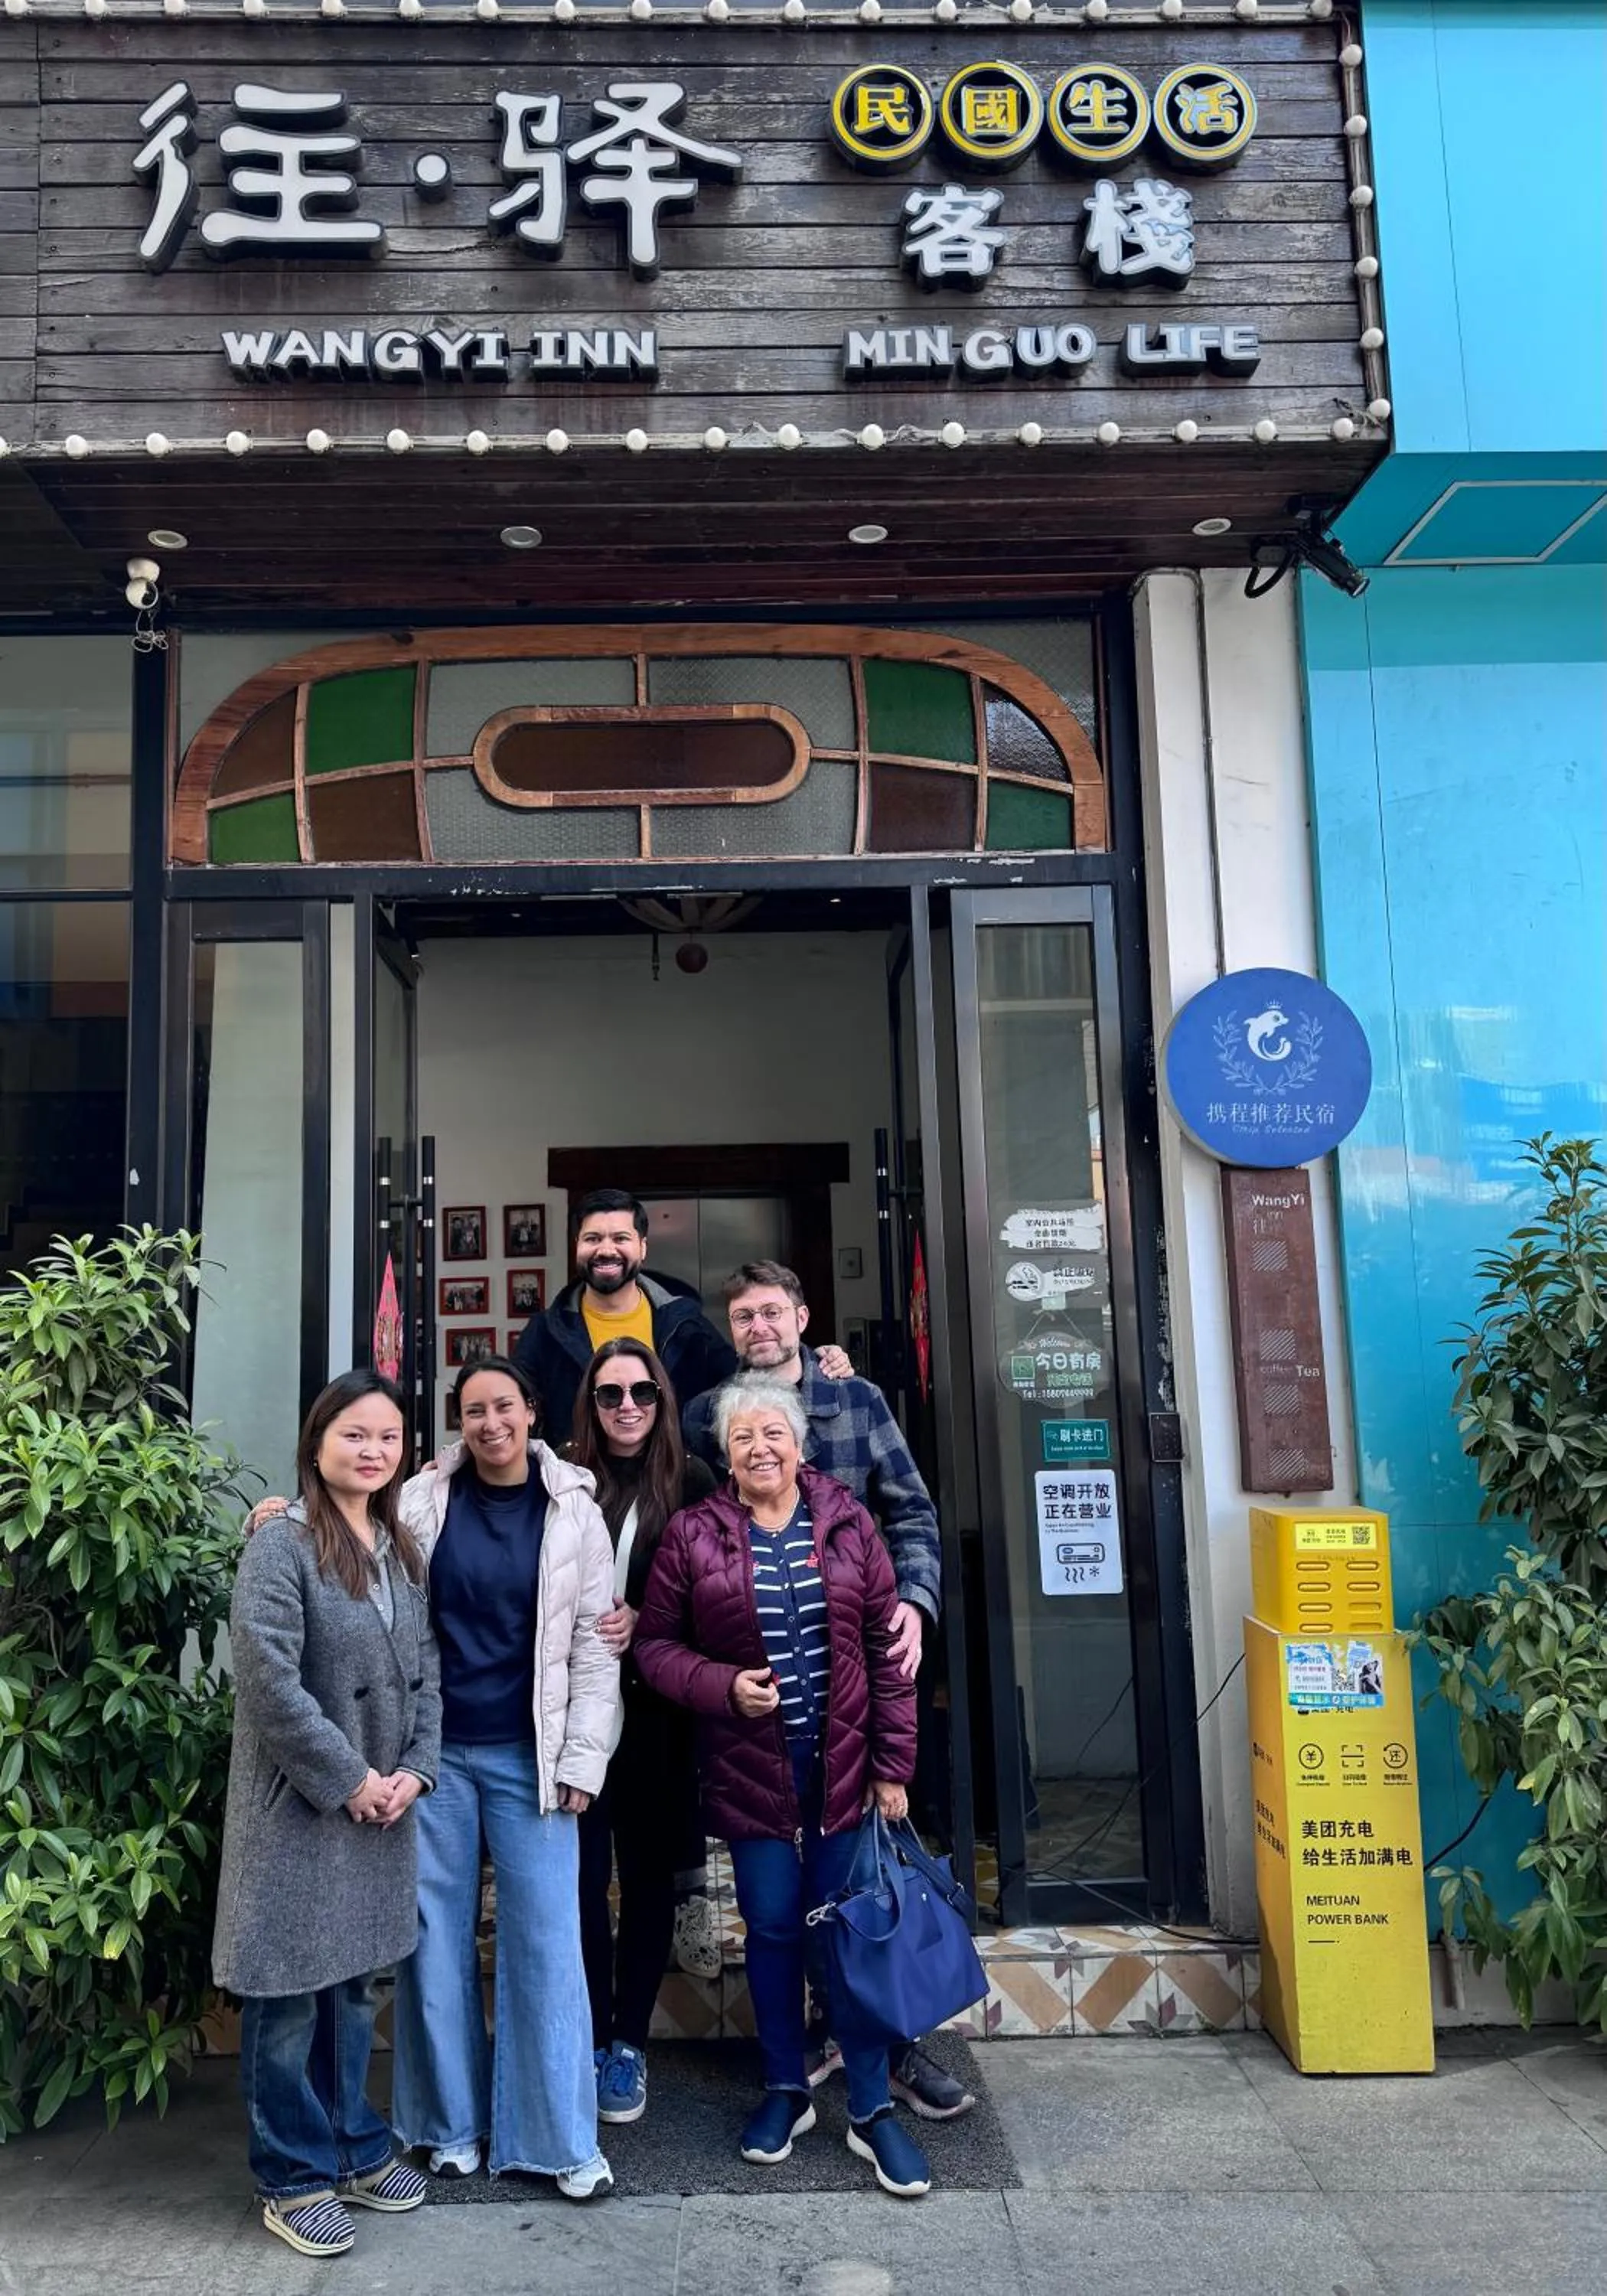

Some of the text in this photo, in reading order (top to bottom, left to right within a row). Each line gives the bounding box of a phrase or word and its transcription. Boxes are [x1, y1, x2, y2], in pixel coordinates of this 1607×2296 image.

[849, 78, 1241, 137] 民國生活
[220, 329, 658, 373] WANGYI INN
[1126, 323, 1261, 366] LIFE
[1206, 1102, 1335, 1124] 携程推荐民宿
[1251, 1193, 1305, 1208] WangYi
[1035, 1352, 1102, 1371] 今日有房
[1296, 1365, 1321, 1377] Tea
[1060, 1427, 1103, 1442] 刷卡进门
[1043, 1482, 1110, 1500] 空调开放
[1045, 1502, 1112, 1519] 正在营业
[1302, 1820, 1374, 1838] 美团充电
[1302, 1848, 1413, 1866] 给生活加满电
[1306, 1896, 1360, 1906] MEITUAN
[1308, 1914, 1390, 1925] POWER BANK
